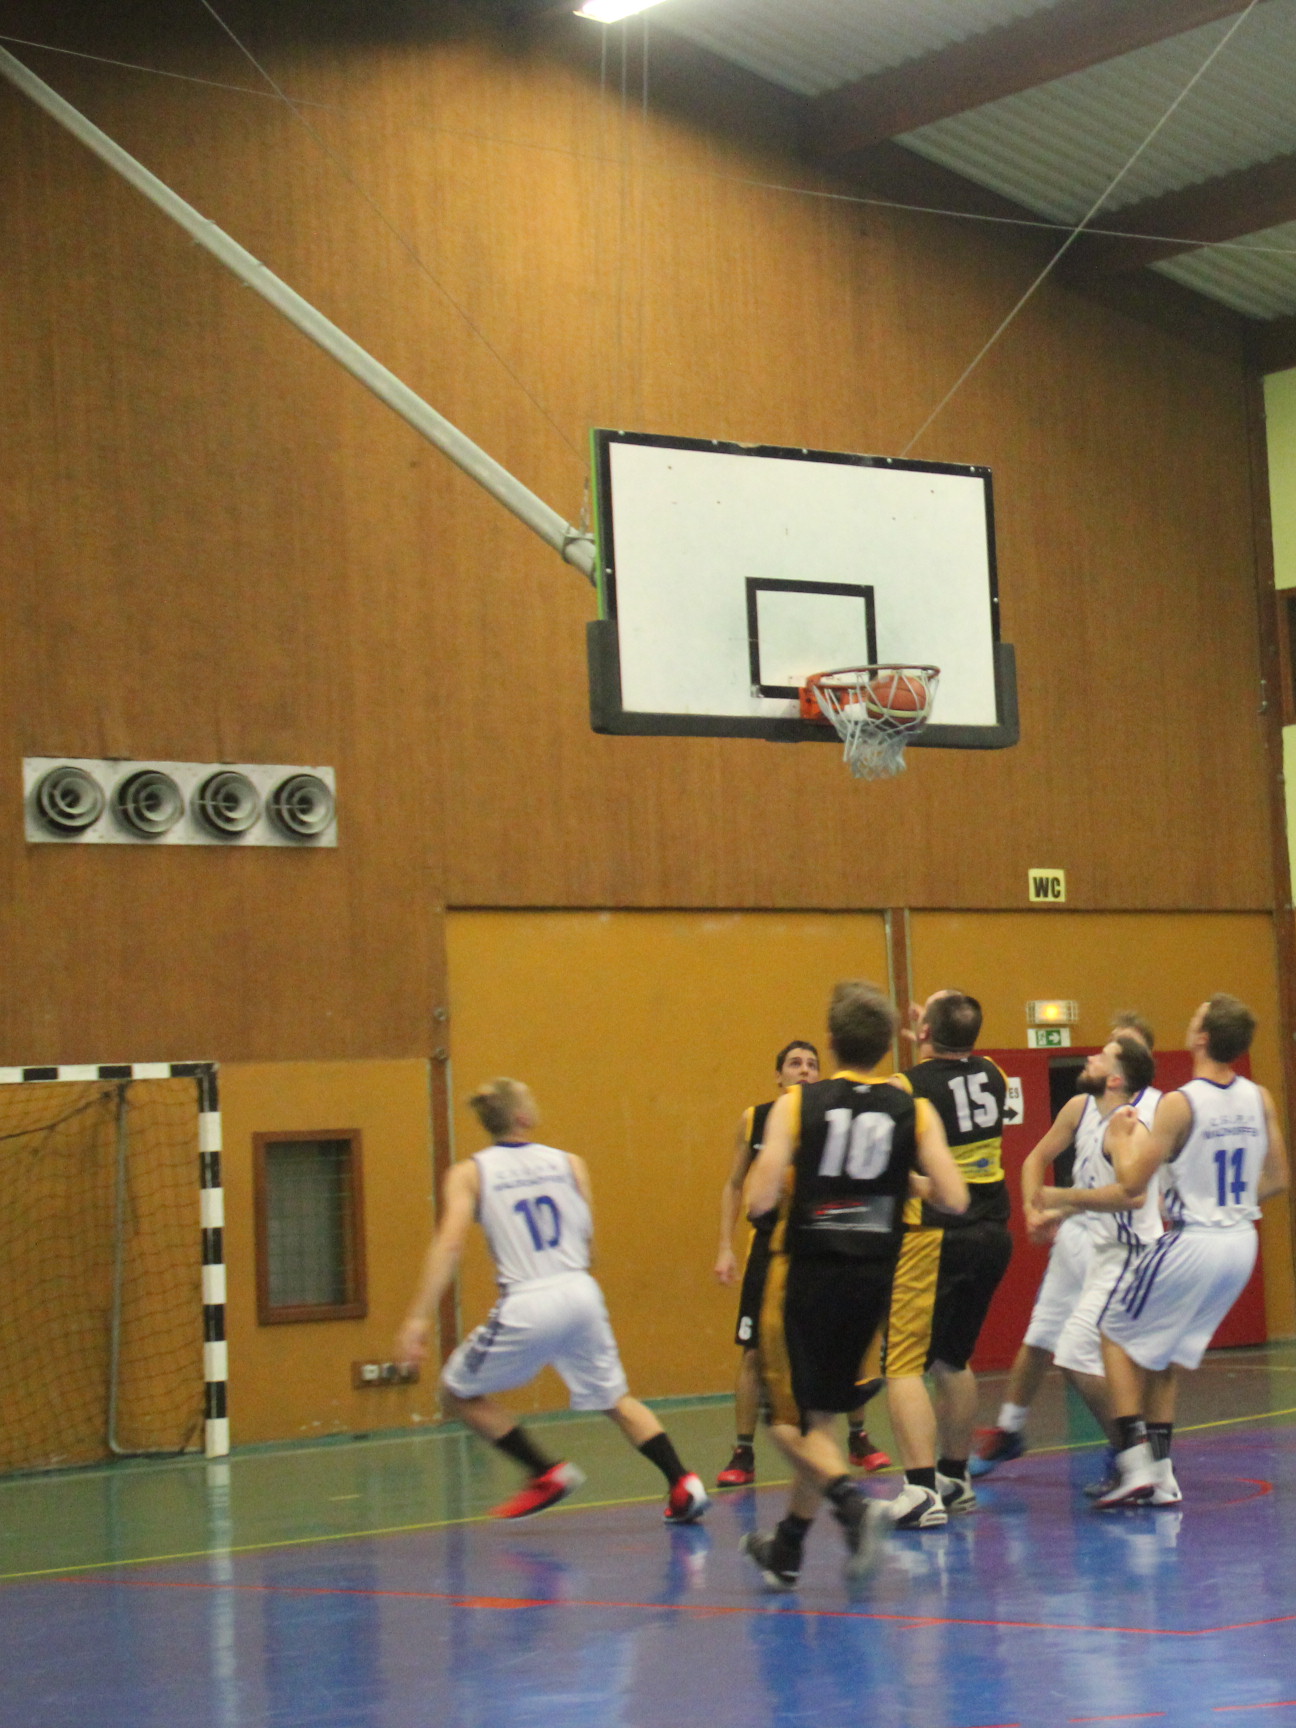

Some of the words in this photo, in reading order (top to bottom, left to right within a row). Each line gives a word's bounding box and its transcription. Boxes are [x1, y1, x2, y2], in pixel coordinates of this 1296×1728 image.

[1032, 876, 1062, 899] WC
[947, 1071, 999, 1132] 15
[818, 1107, 897, 1180] 10
[513, 1195, 562, 1252] 10
